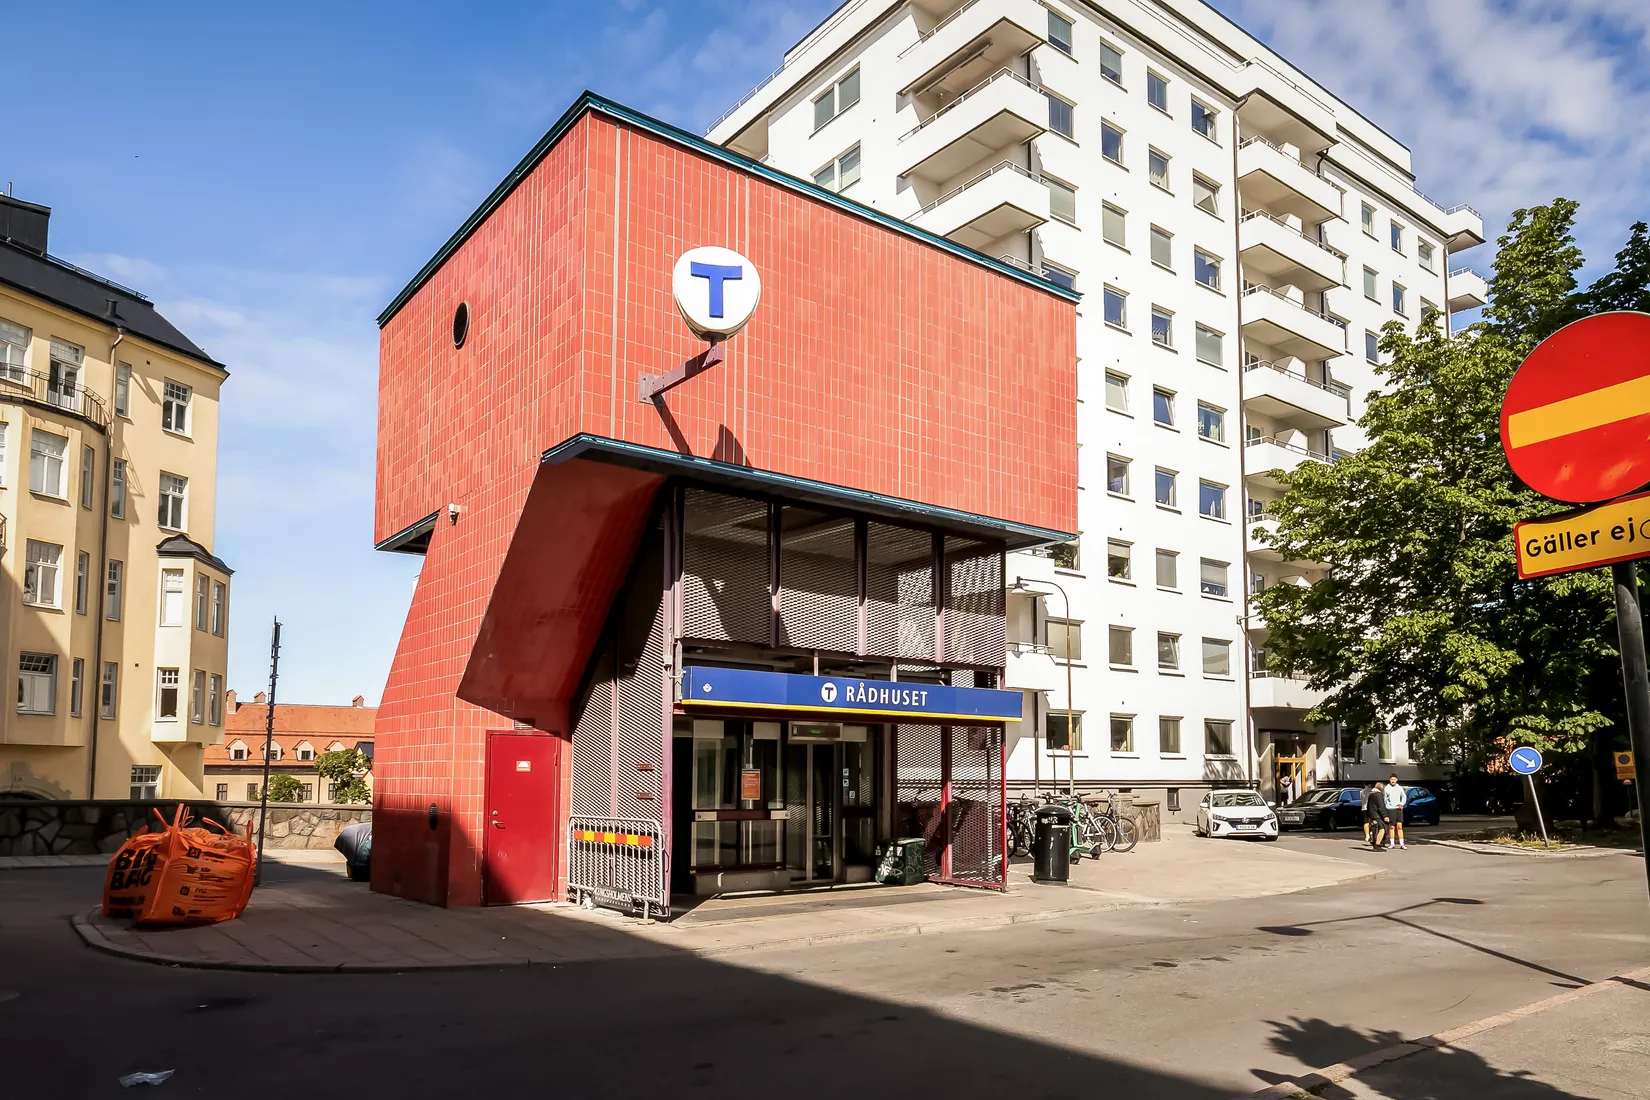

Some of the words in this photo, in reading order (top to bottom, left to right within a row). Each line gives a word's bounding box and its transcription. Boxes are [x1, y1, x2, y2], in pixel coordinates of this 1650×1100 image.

[690, 261, 742, 318] T
[1526, 530, 1600, 557] Gäller
[1611, 517, 1635, 543] ej
[846, 682, 928, 706] RÅDHUSET
[115, 844, 160, 870] BIG
[110, 866, 154, 890] BAG
